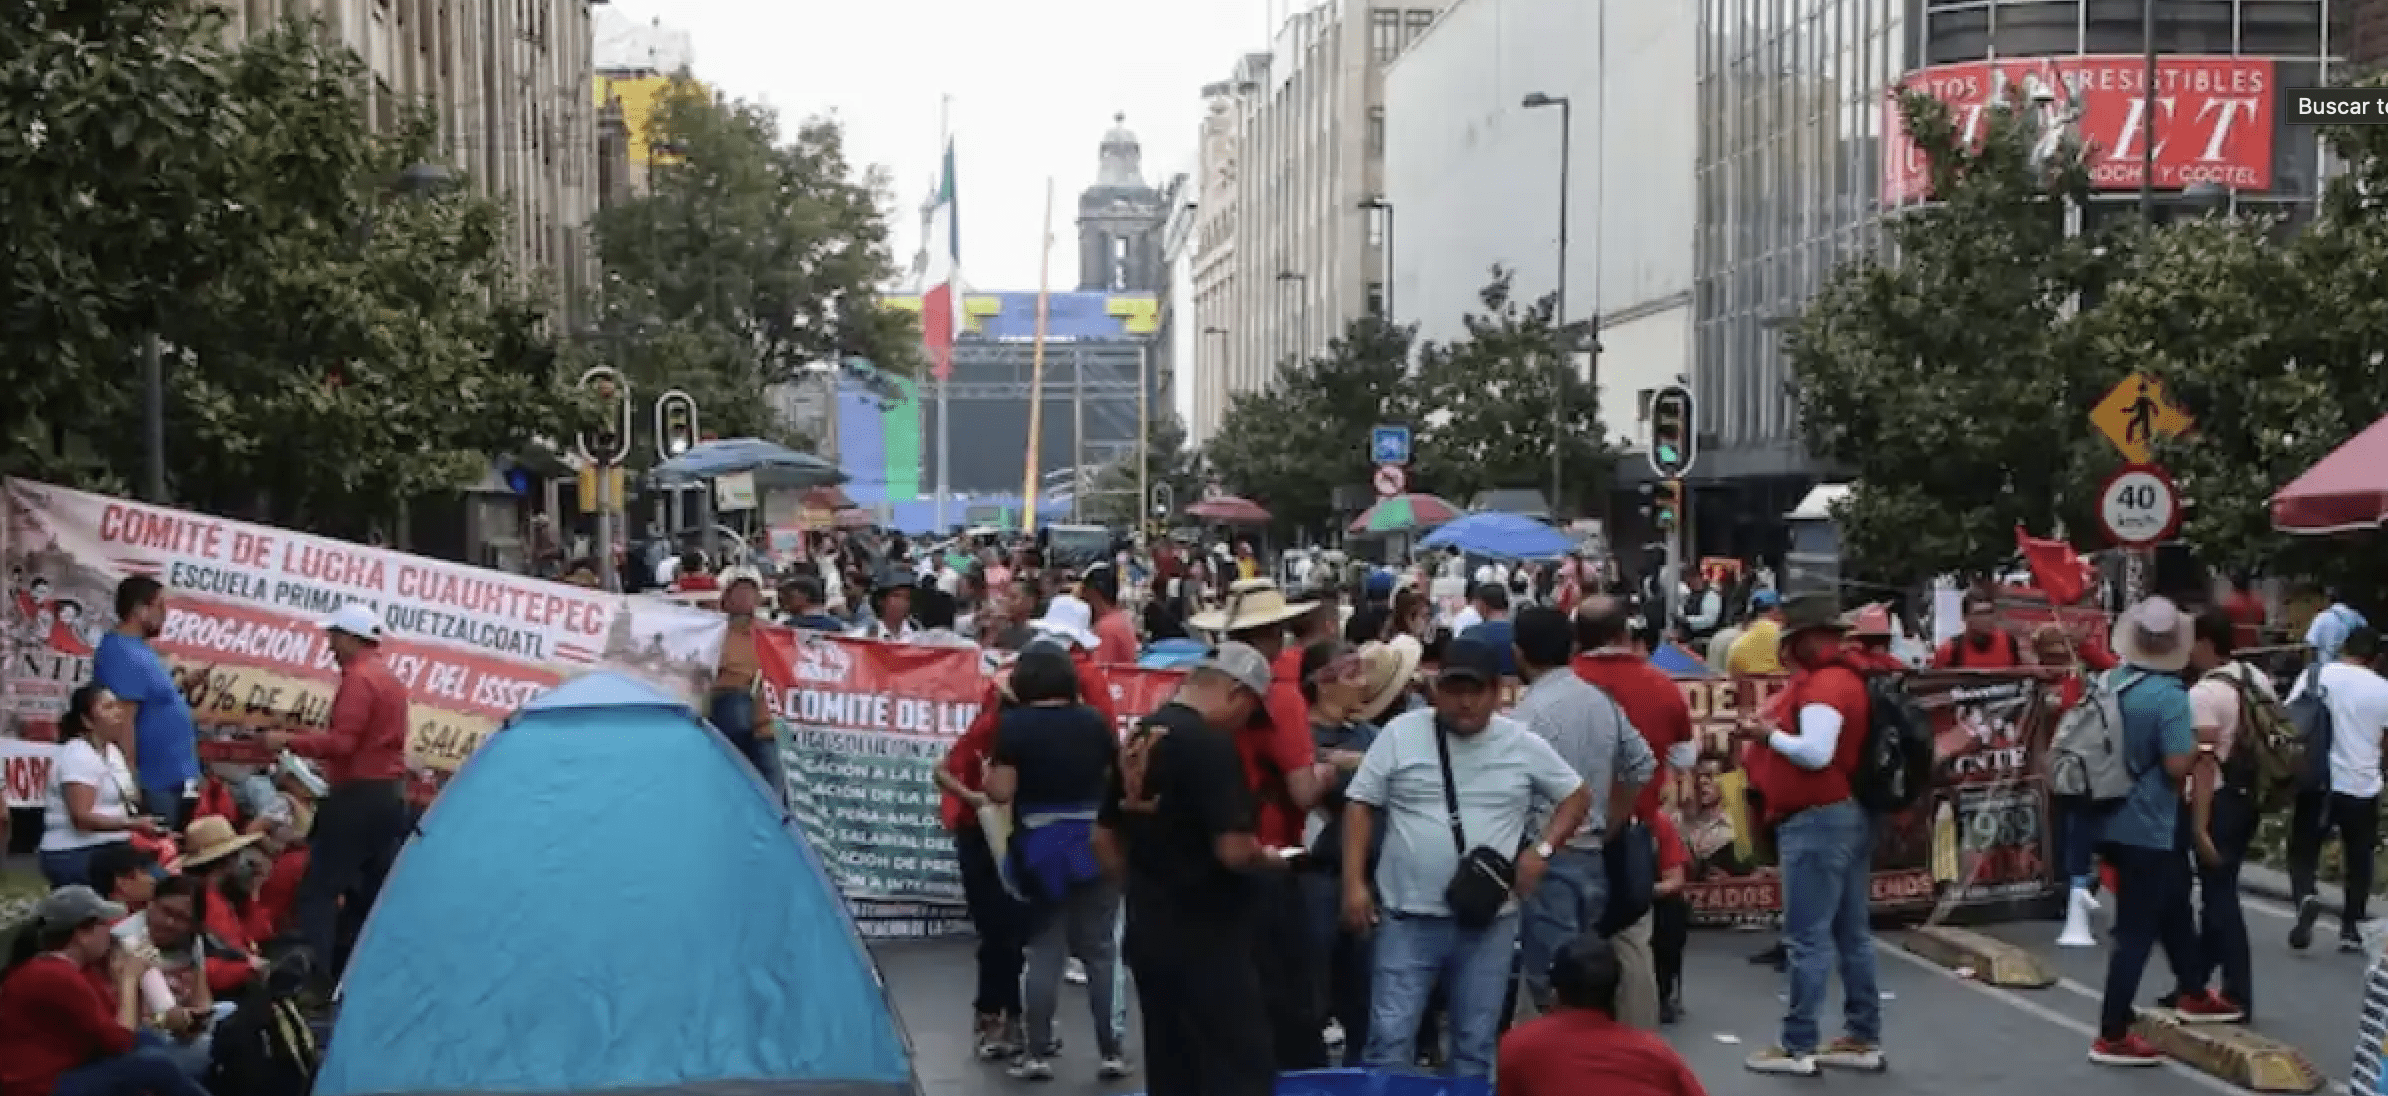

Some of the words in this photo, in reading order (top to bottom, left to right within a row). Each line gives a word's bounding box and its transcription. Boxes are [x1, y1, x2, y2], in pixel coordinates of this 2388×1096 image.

[2050, 68, 2263, 92] IRESITIBLES
[2117, 485, 2155, 509] 40
[230, 530, 274, 569] DE
[281, 540, 385, 592] LUCHA
[398, 564, 604, 636] CUAUHTEPEC
[169, 561, 267, 600] ESCUELA
[385, 602, 545, 659] QUETZALCOATL
[158, 608, 315, 665] BROGACIÓN
[424, 660, 470, 700] DEL
[470, 672, 548, 711] ISSST
[895, 697, 934, 732] DE
[1683, 681, 1739, 717] DE
[244, 683, 283, 715] DE
[414, 721, 483, 760] SALA
[1683, 884, 1774, 909] ZADOS
